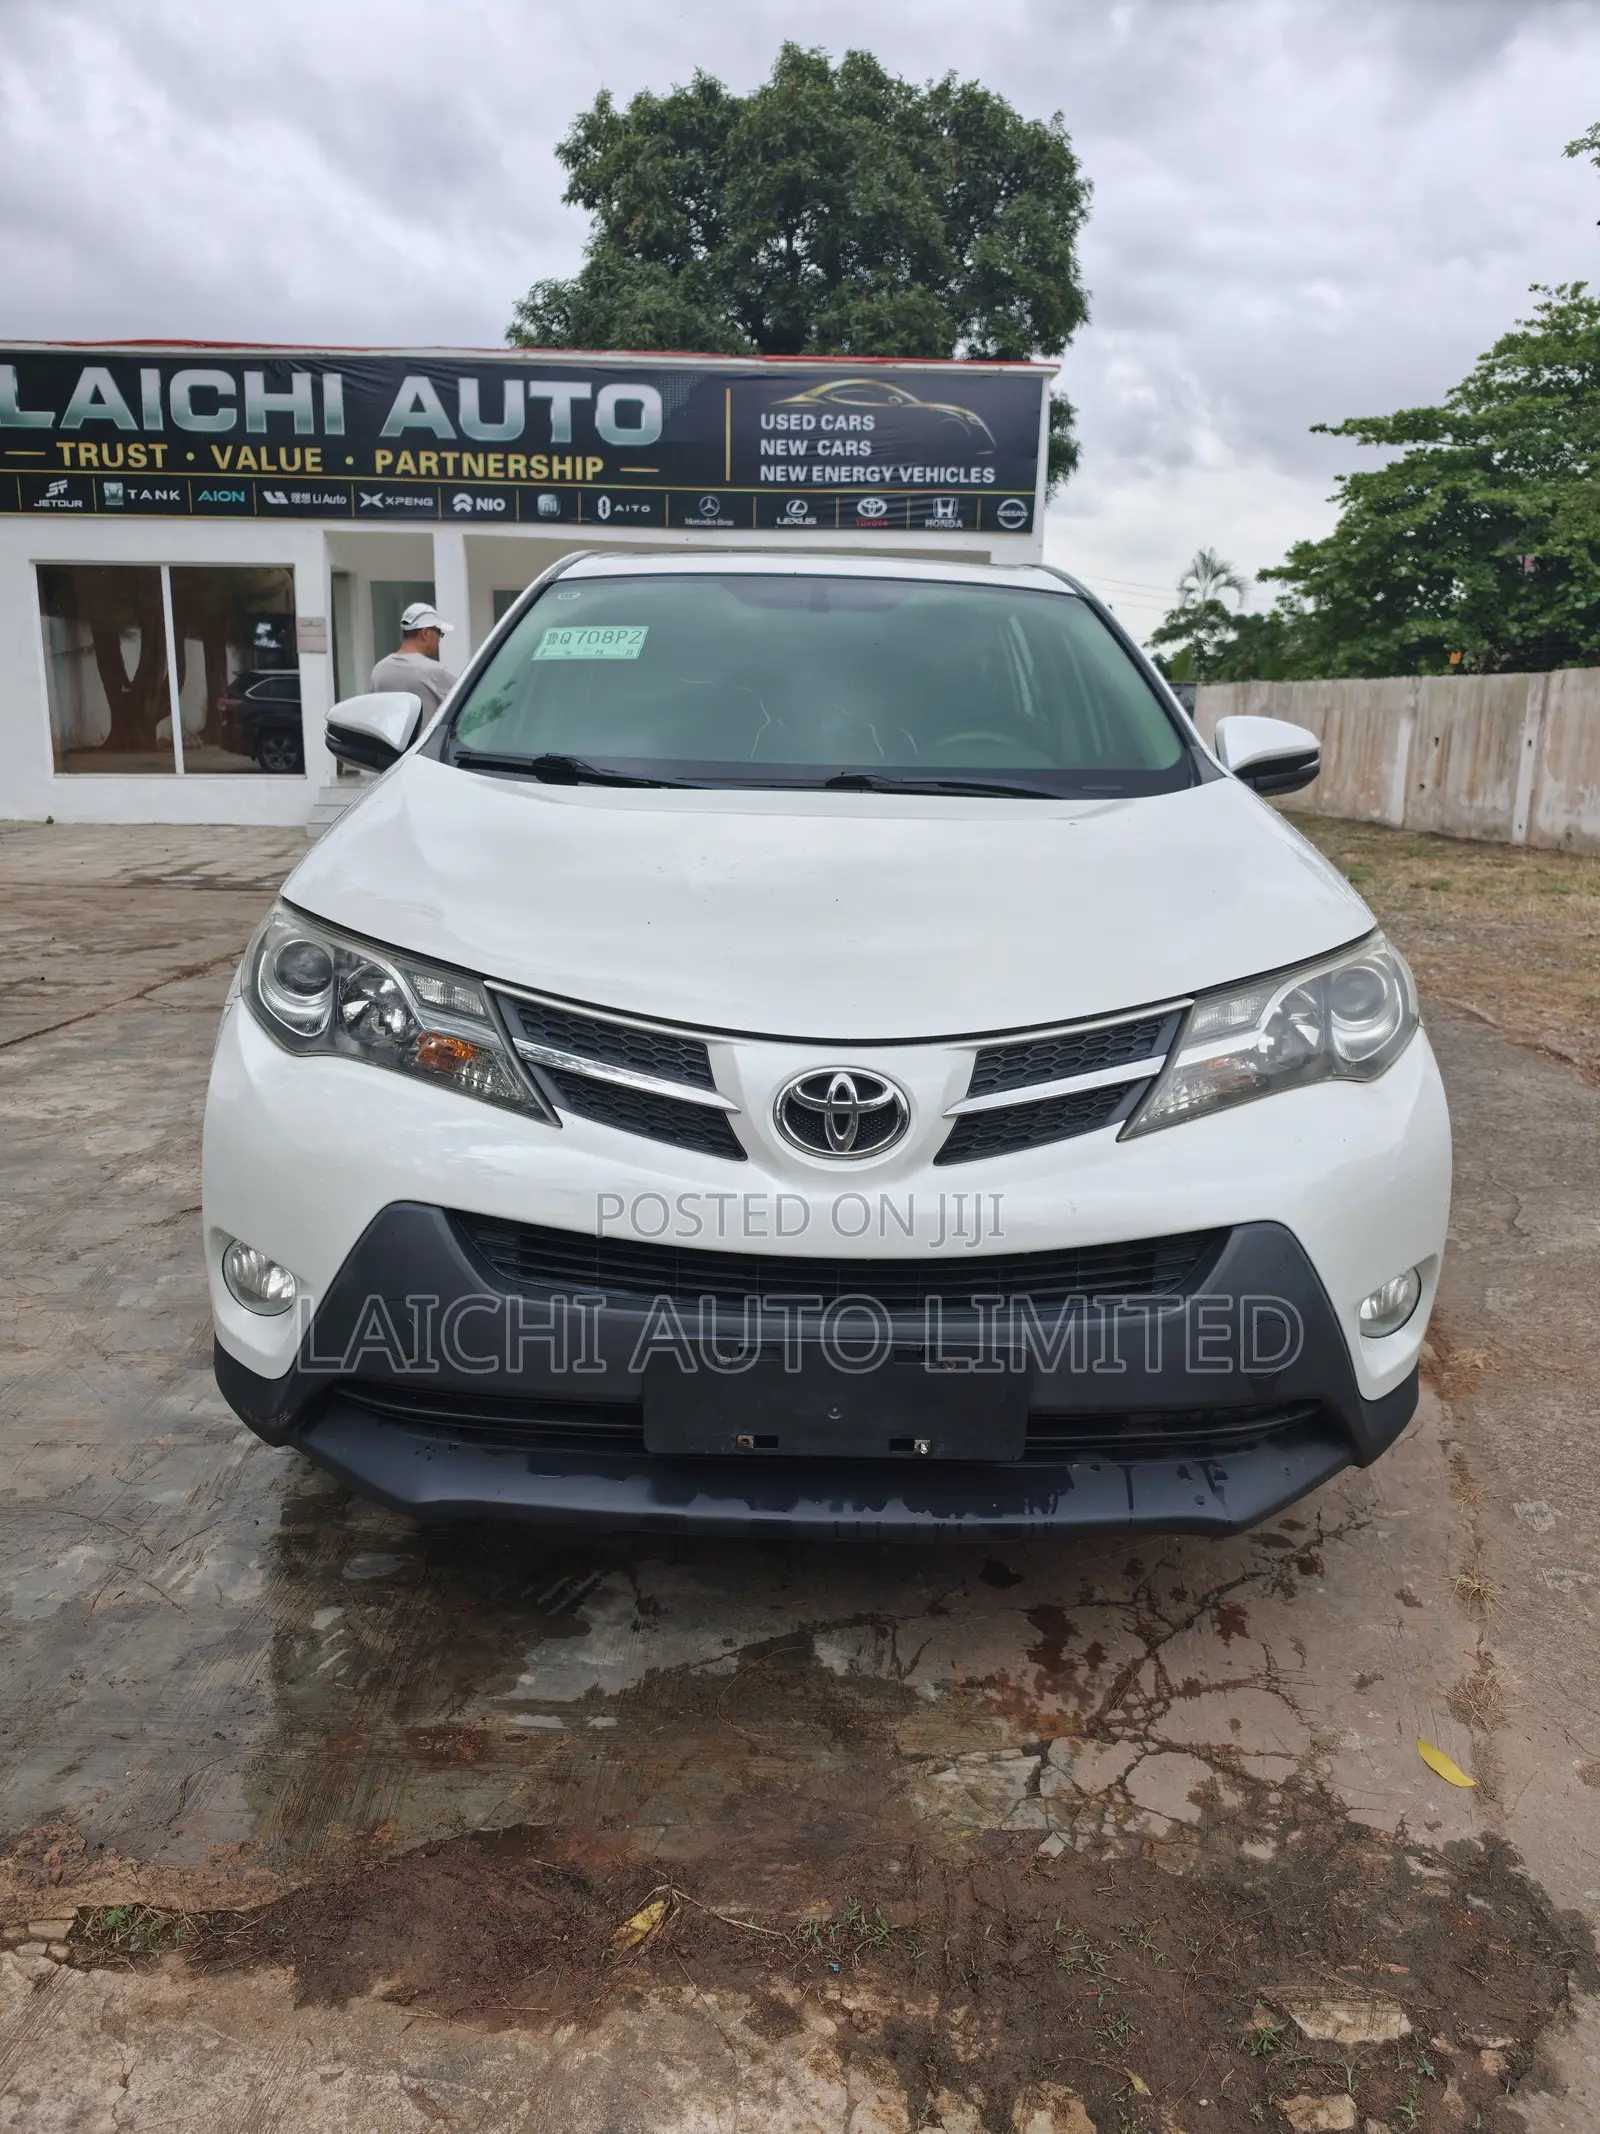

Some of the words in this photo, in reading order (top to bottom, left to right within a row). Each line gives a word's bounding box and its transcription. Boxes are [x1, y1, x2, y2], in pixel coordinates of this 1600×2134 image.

[0, 364, 345, 436] LAICHI
[379, 375, 663, 446] AUTO
[760, 413, 816, 431] USED
[820, 415, 875, 432] CARS
[760, 439, 808, 456] NEW
[817, 440, 872, 457] CARS
[56, 441, 168, 469] TRUST
[210, 444, 323, 473] VALUE
[374, 449, 604, 480] PARTNERSHIP
[760, 465, 809, 482] NEW
[812, 466, 897, 483] ENERGY
[898, 467, 996, 484] VEHICLES
[127, 489, 181, 501] TANK
[197, 490, 245, 502] AION
[313, 494, 322, 504] Li
[323, 493, 347, 505] Auto
[33, 499, 83, 508] JETOUR
[385, 496, 433, 507] XPENG
[476, 498, 506, 512] NIO
[614, 504, 651, 513] AITO
[776, 517, 817, 525] LEXUS
[924, 520, 963, 528] HONDA
